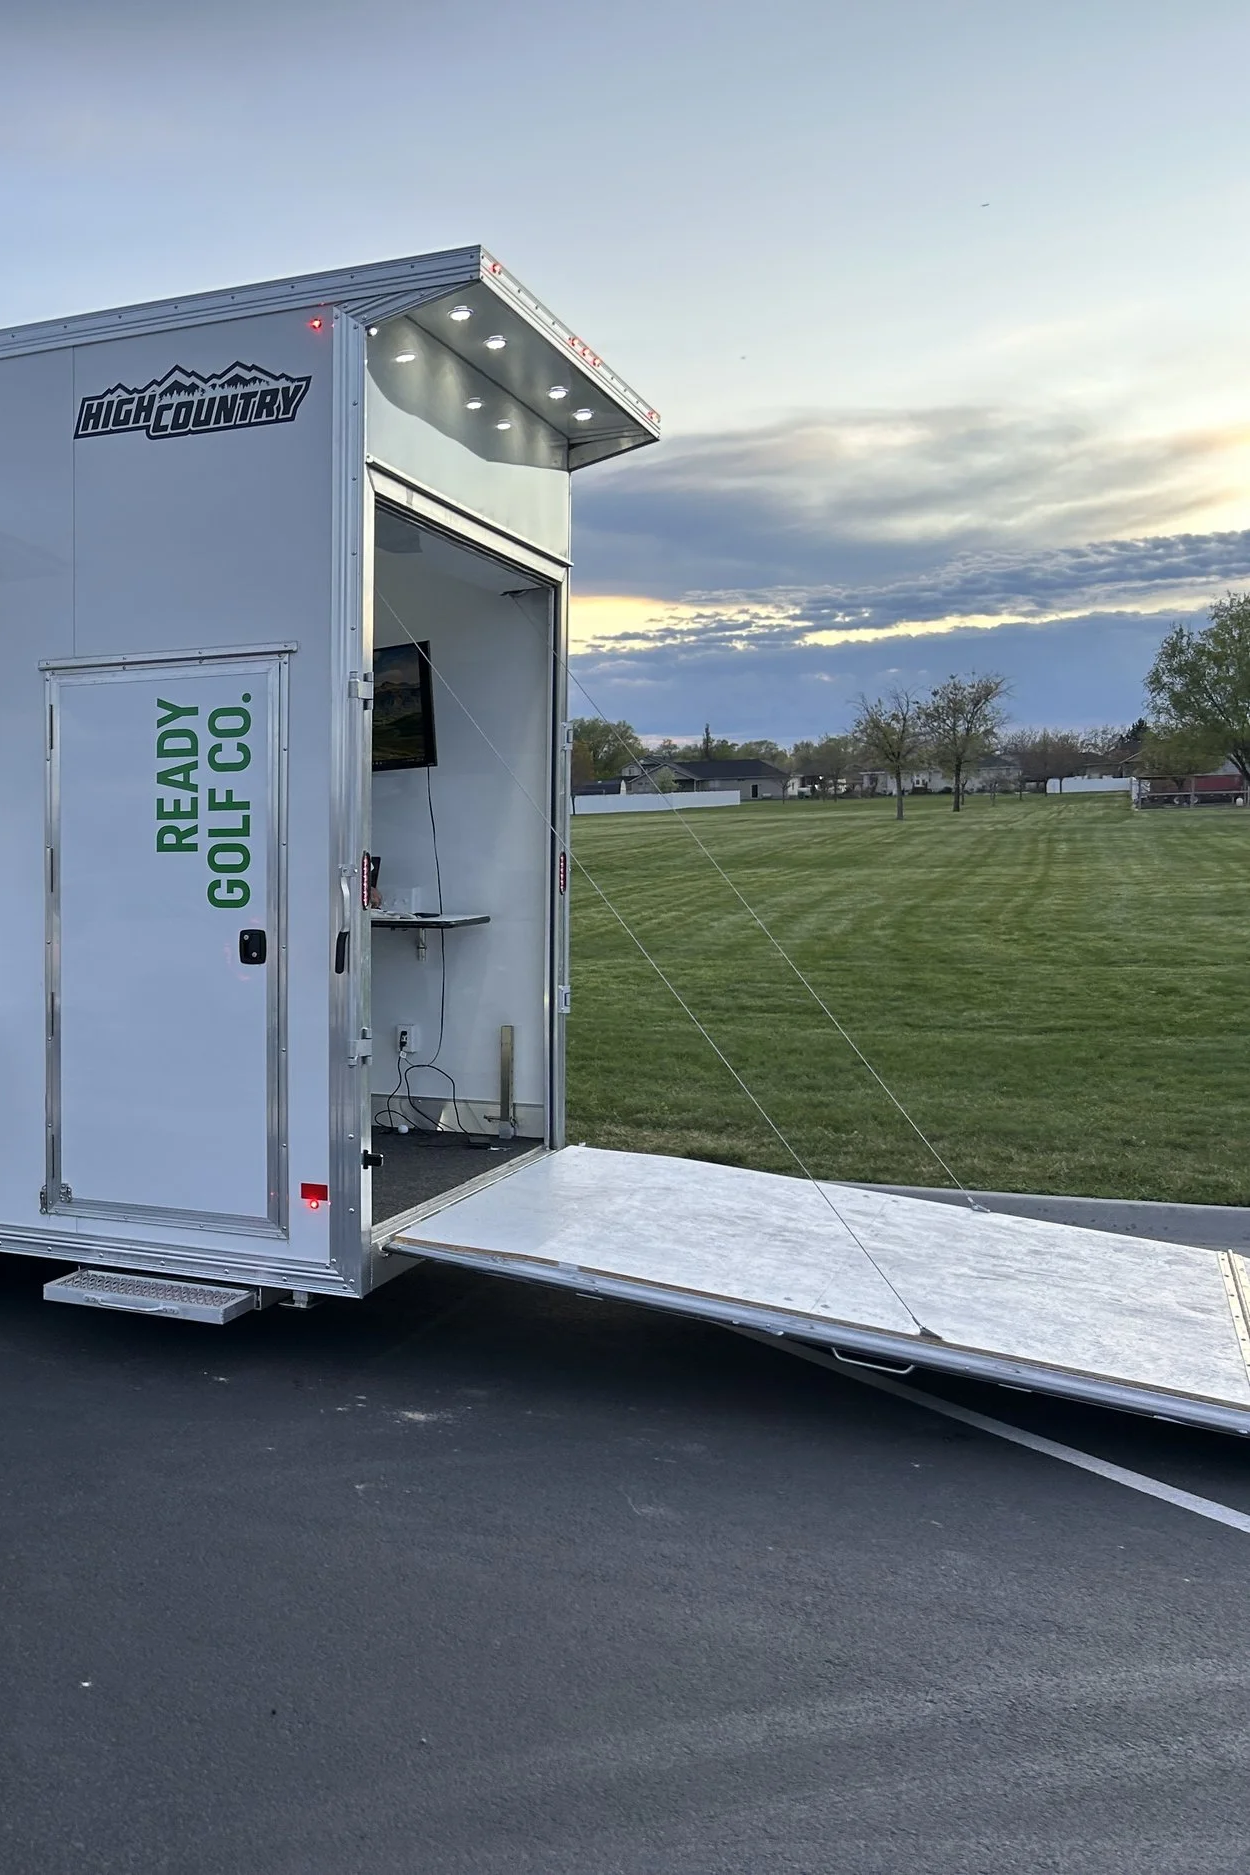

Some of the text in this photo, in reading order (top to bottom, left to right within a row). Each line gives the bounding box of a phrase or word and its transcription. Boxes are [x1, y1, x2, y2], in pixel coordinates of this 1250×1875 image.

[156, 697, 199, 853] READY
[206, 692, 252, 909] GOLF CO.
